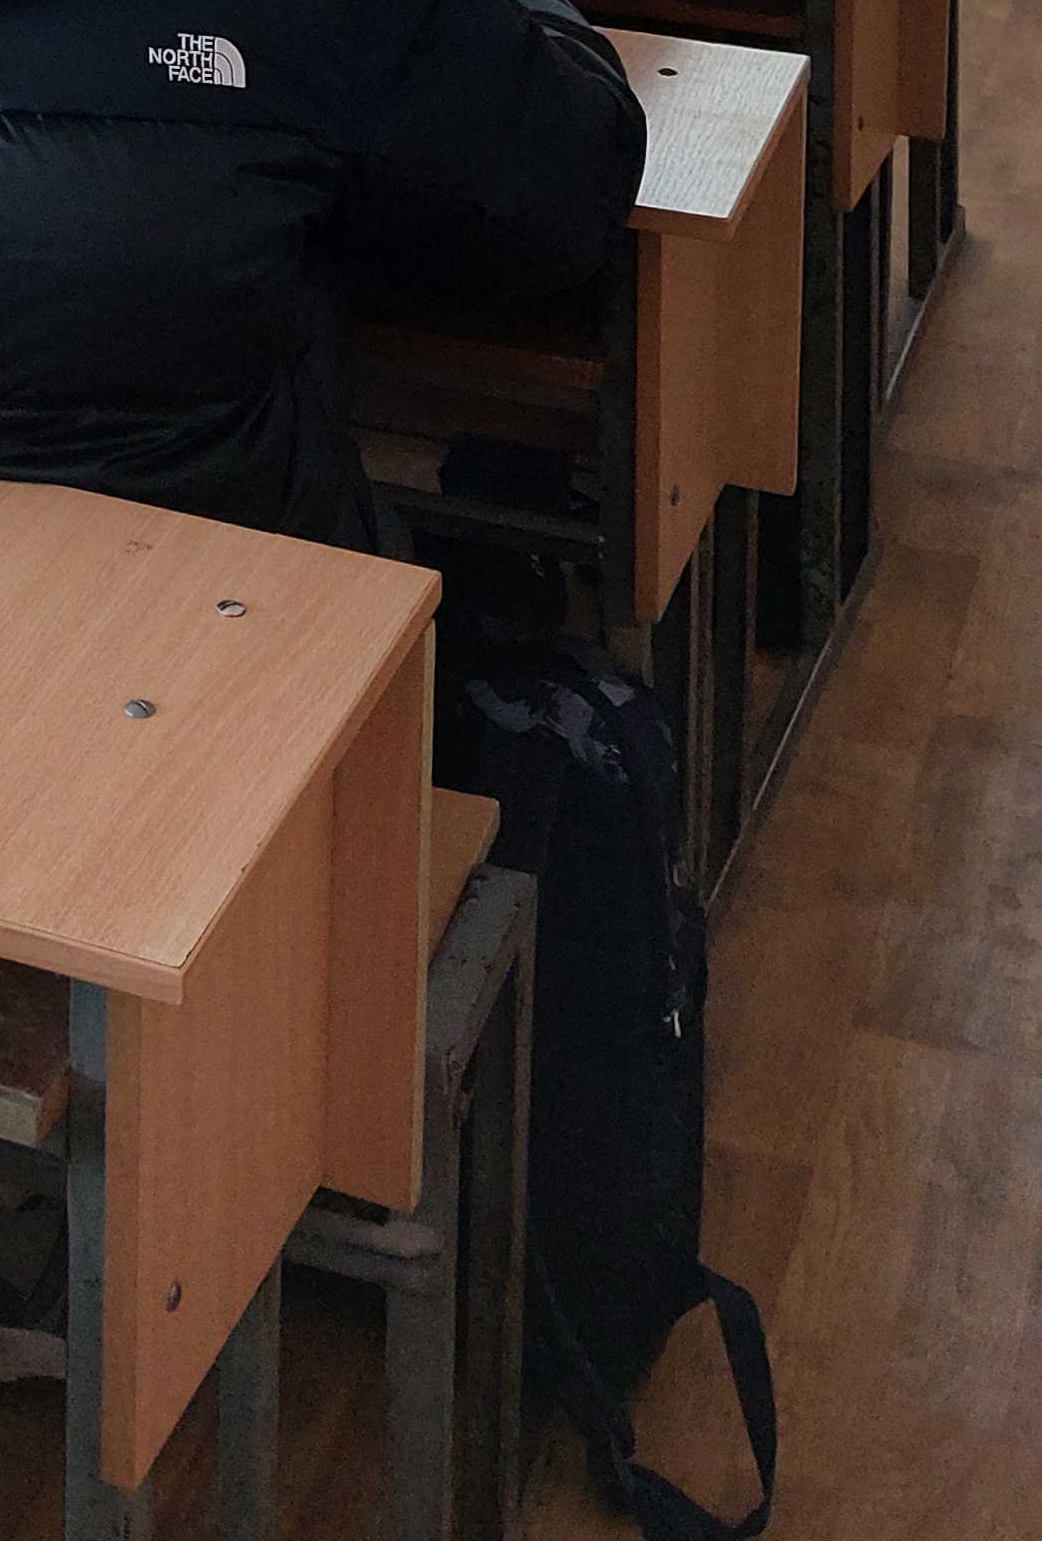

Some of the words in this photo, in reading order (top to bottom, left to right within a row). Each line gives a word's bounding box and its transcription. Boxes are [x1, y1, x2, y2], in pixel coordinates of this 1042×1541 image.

[177, 33, 215, 52] THE
[148, 47, 214, 68] NORTH
[168, 66, 214, 84] FACE
